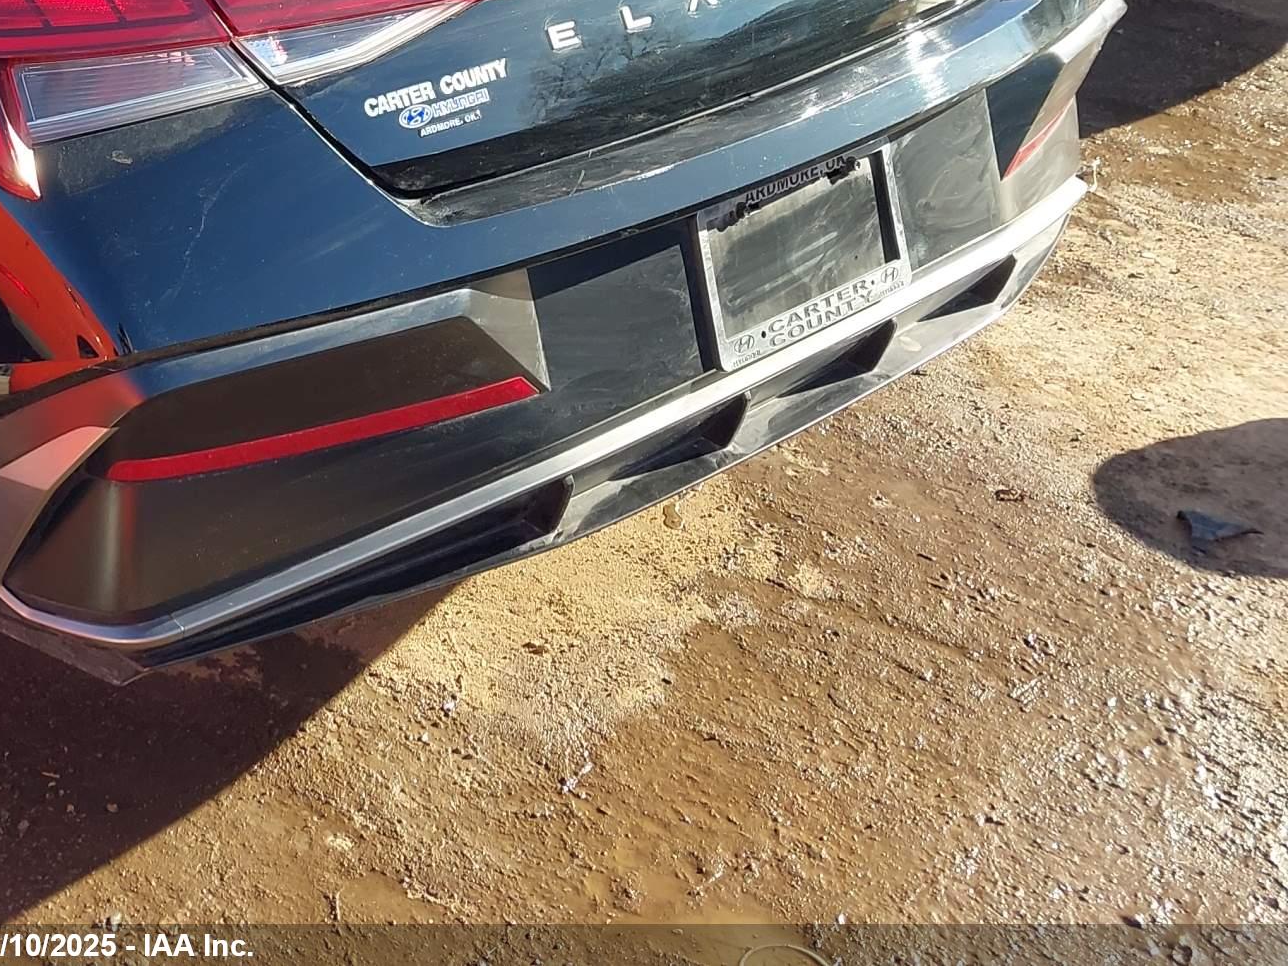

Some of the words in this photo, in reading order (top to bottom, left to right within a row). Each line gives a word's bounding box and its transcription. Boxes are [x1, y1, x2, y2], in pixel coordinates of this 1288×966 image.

[364, 81, 438, 117] CARTER
[440, 58, 508, 95] COUNTY
[768, 280, 870, 333] CARTER
[768, 289, 874, 348] COUNTY
